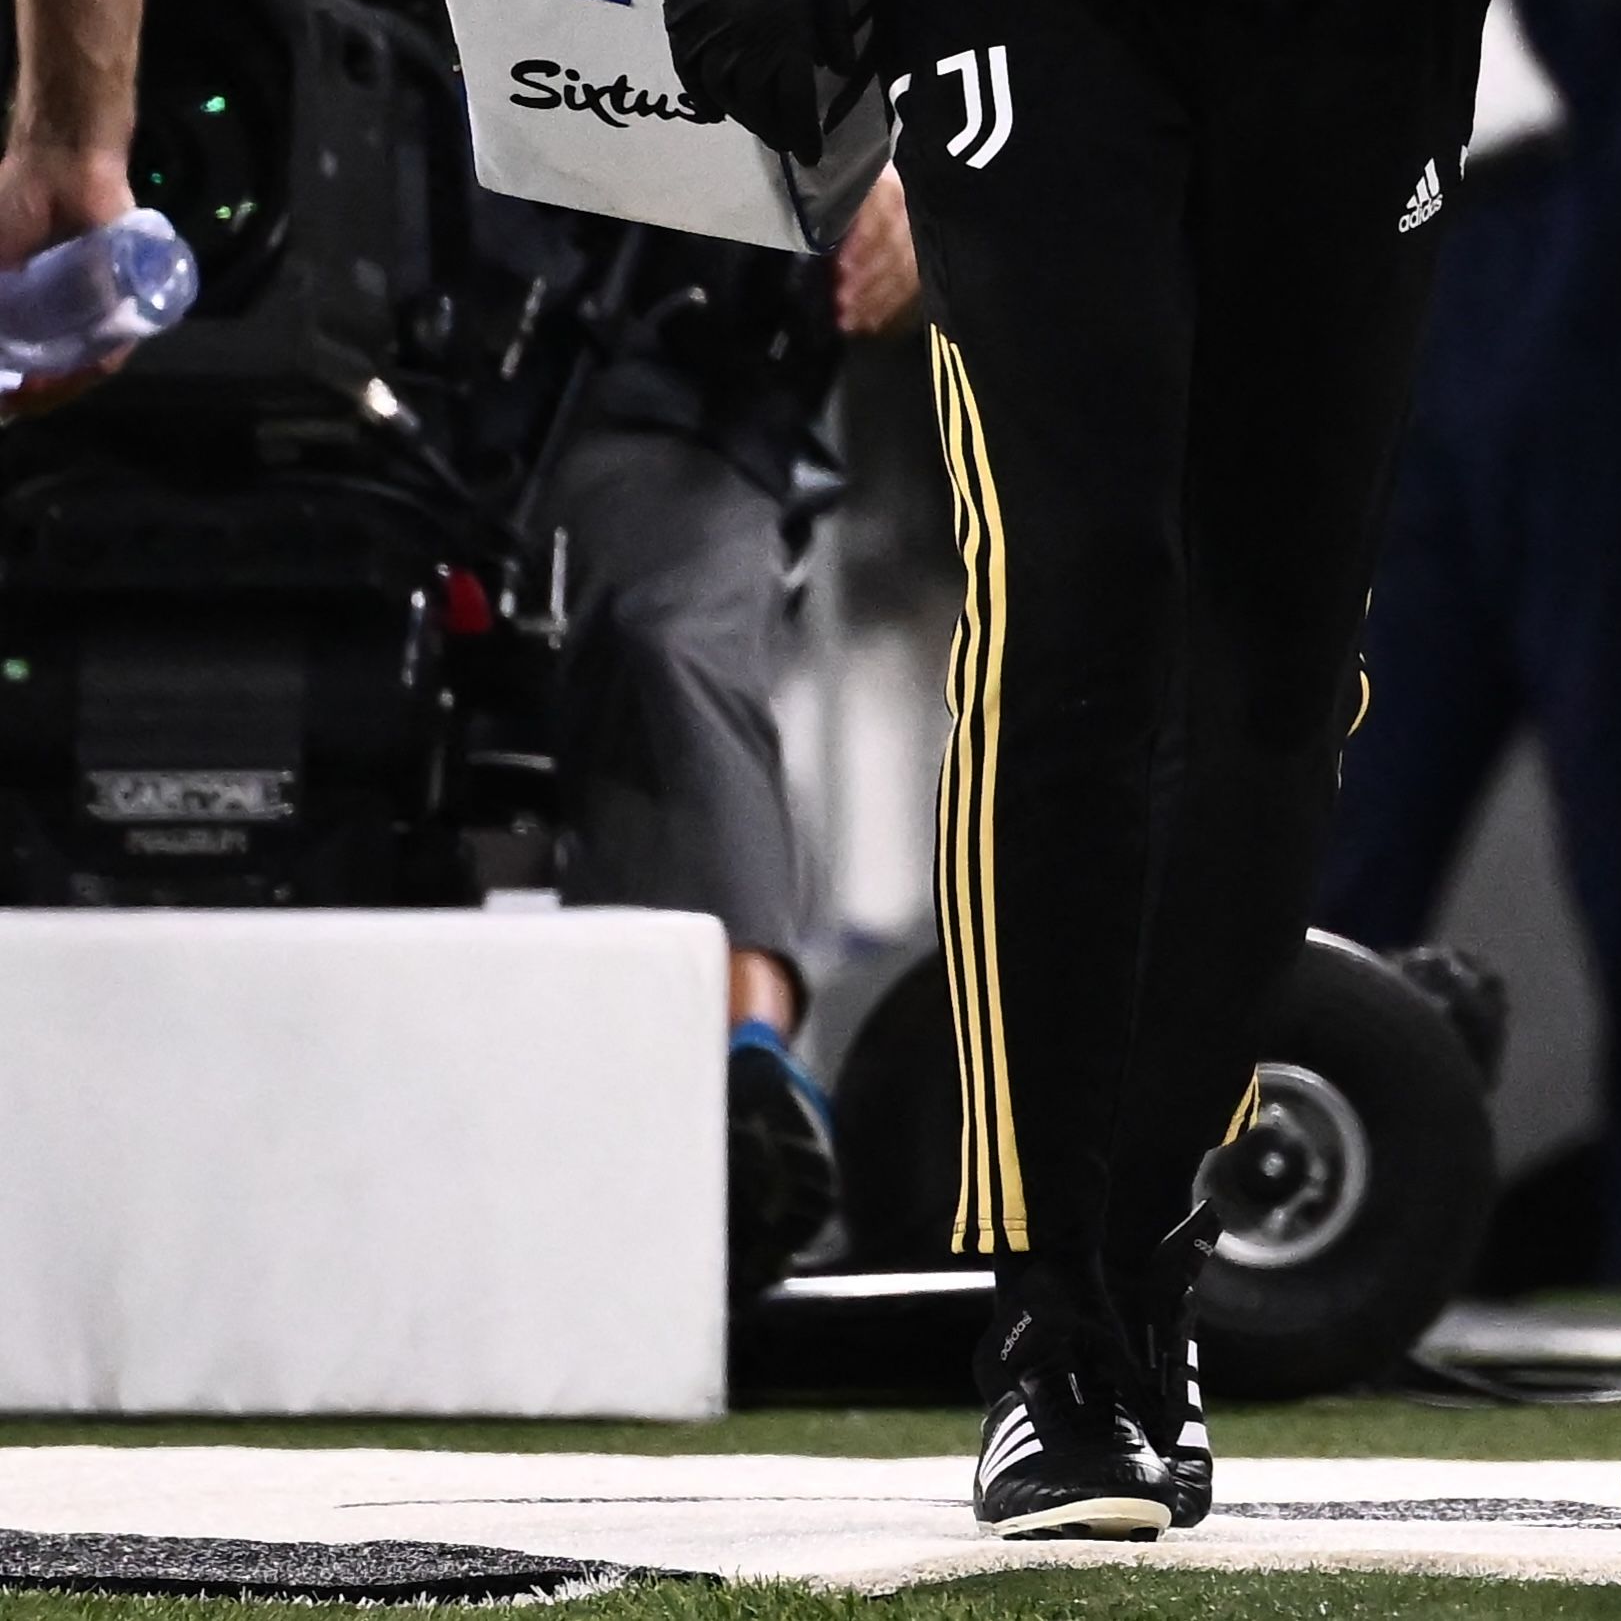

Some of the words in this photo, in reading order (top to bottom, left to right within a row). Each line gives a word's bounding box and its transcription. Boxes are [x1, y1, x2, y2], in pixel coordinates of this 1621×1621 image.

[509, 59, 728, 128] Sixtus
[1398, 193, 1443, 233] adidas
[1000, 1311, 1032, 1361] adidas
